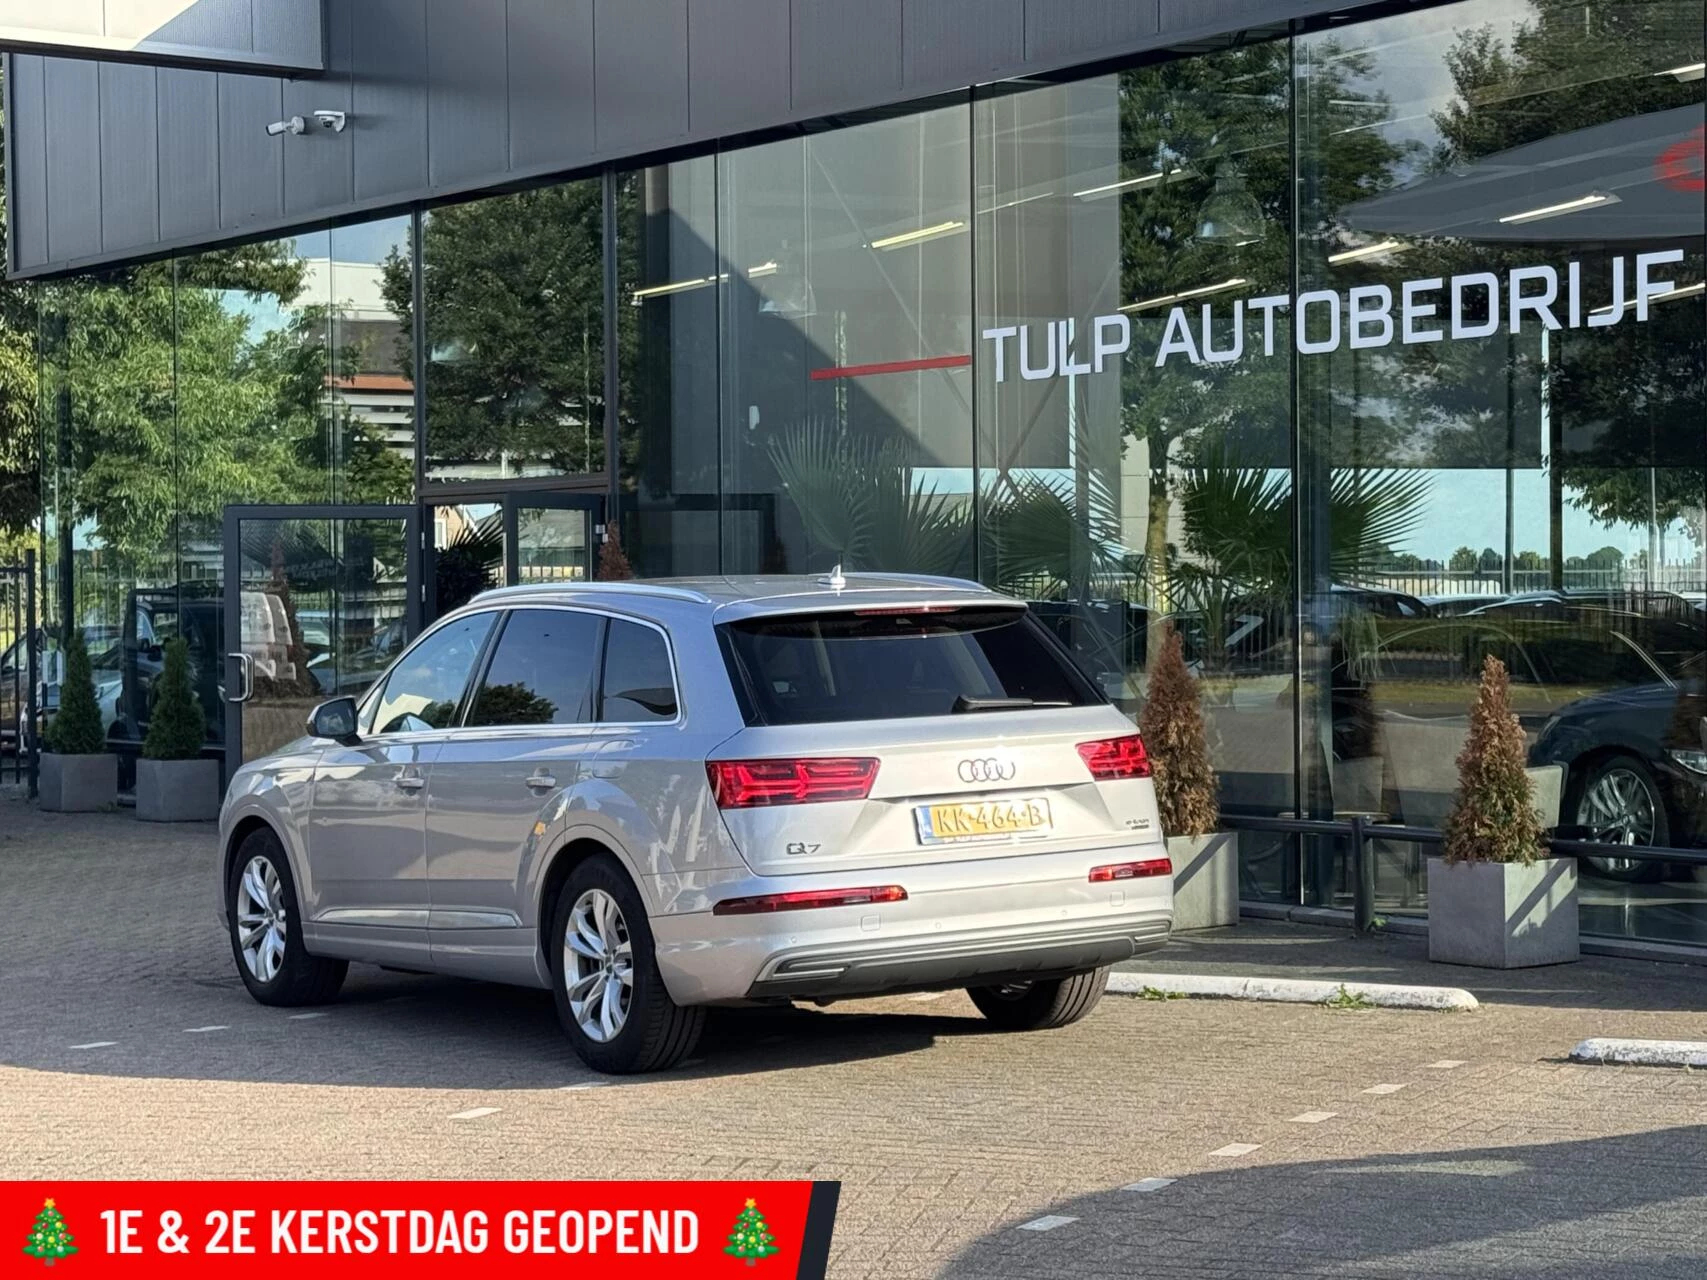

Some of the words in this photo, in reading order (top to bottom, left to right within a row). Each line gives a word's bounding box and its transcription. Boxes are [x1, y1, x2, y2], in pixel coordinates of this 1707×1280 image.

[983, 313, 1131, 383] TULP
[1155, 249, 1684, 368] AUTOBEDRIJF
[936, 803, 1044, 833] KK-464-B
[786, 842, 821, 855] Q7
